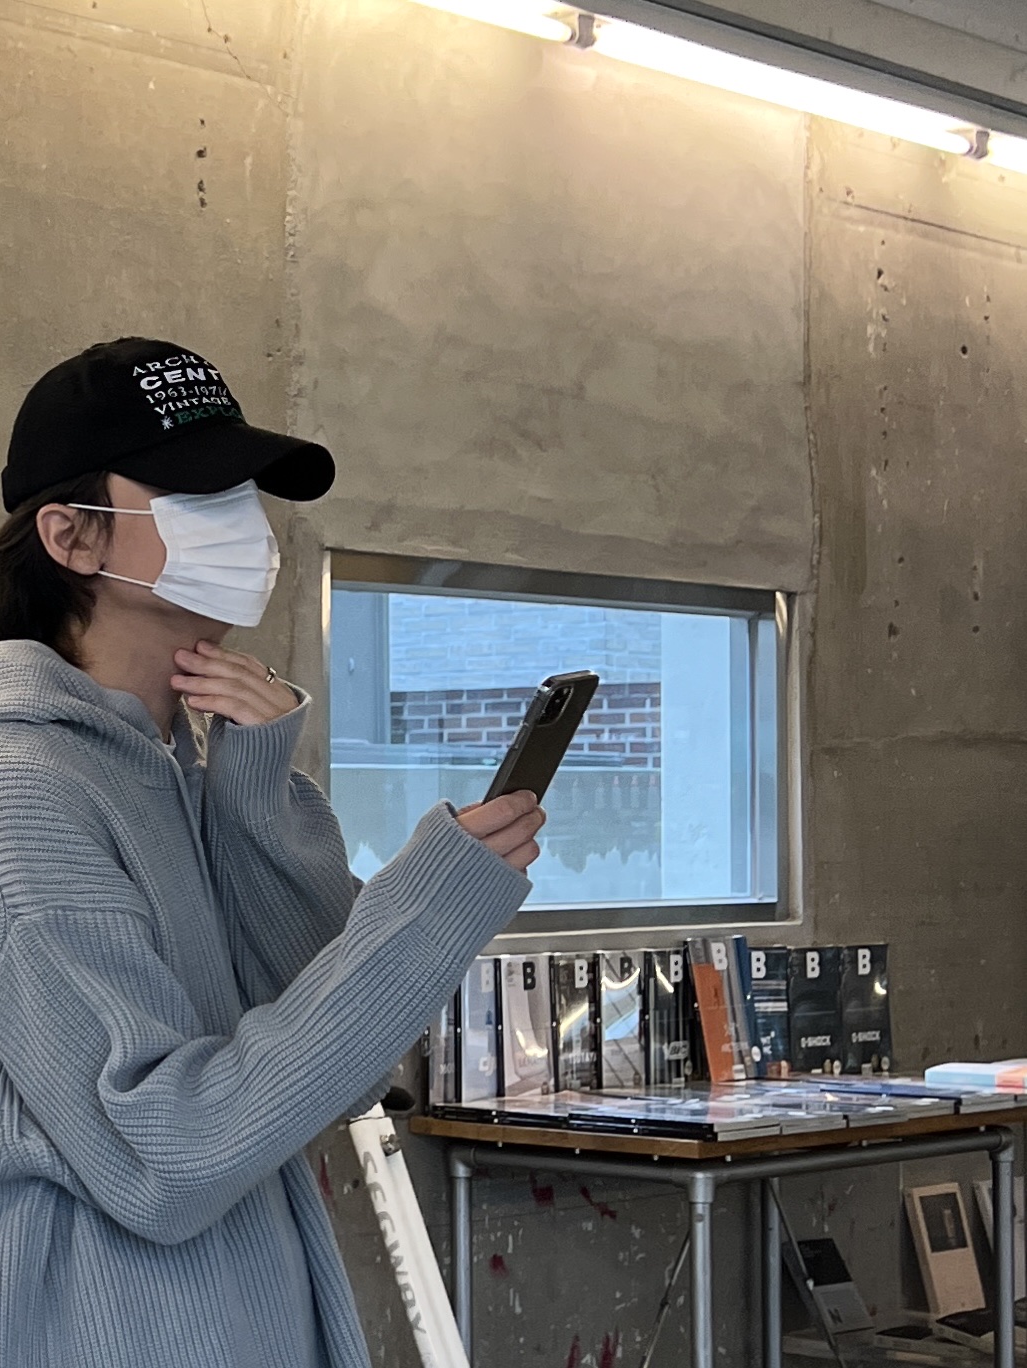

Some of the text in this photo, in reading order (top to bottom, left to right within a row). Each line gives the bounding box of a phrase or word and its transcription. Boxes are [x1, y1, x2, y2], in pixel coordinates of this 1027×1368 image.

[153, 396, 232, 415] VINTAGE
[522, 961, 537, 990] B
[574, 958, 589, 989] B
[669, 954, 683, 983] B
[751, 951, 766, 979] B
[806, 951, 821, 979] B
[857, 948, 872, 976] B
[361, 1150, 428, 1336] SEGWAY
